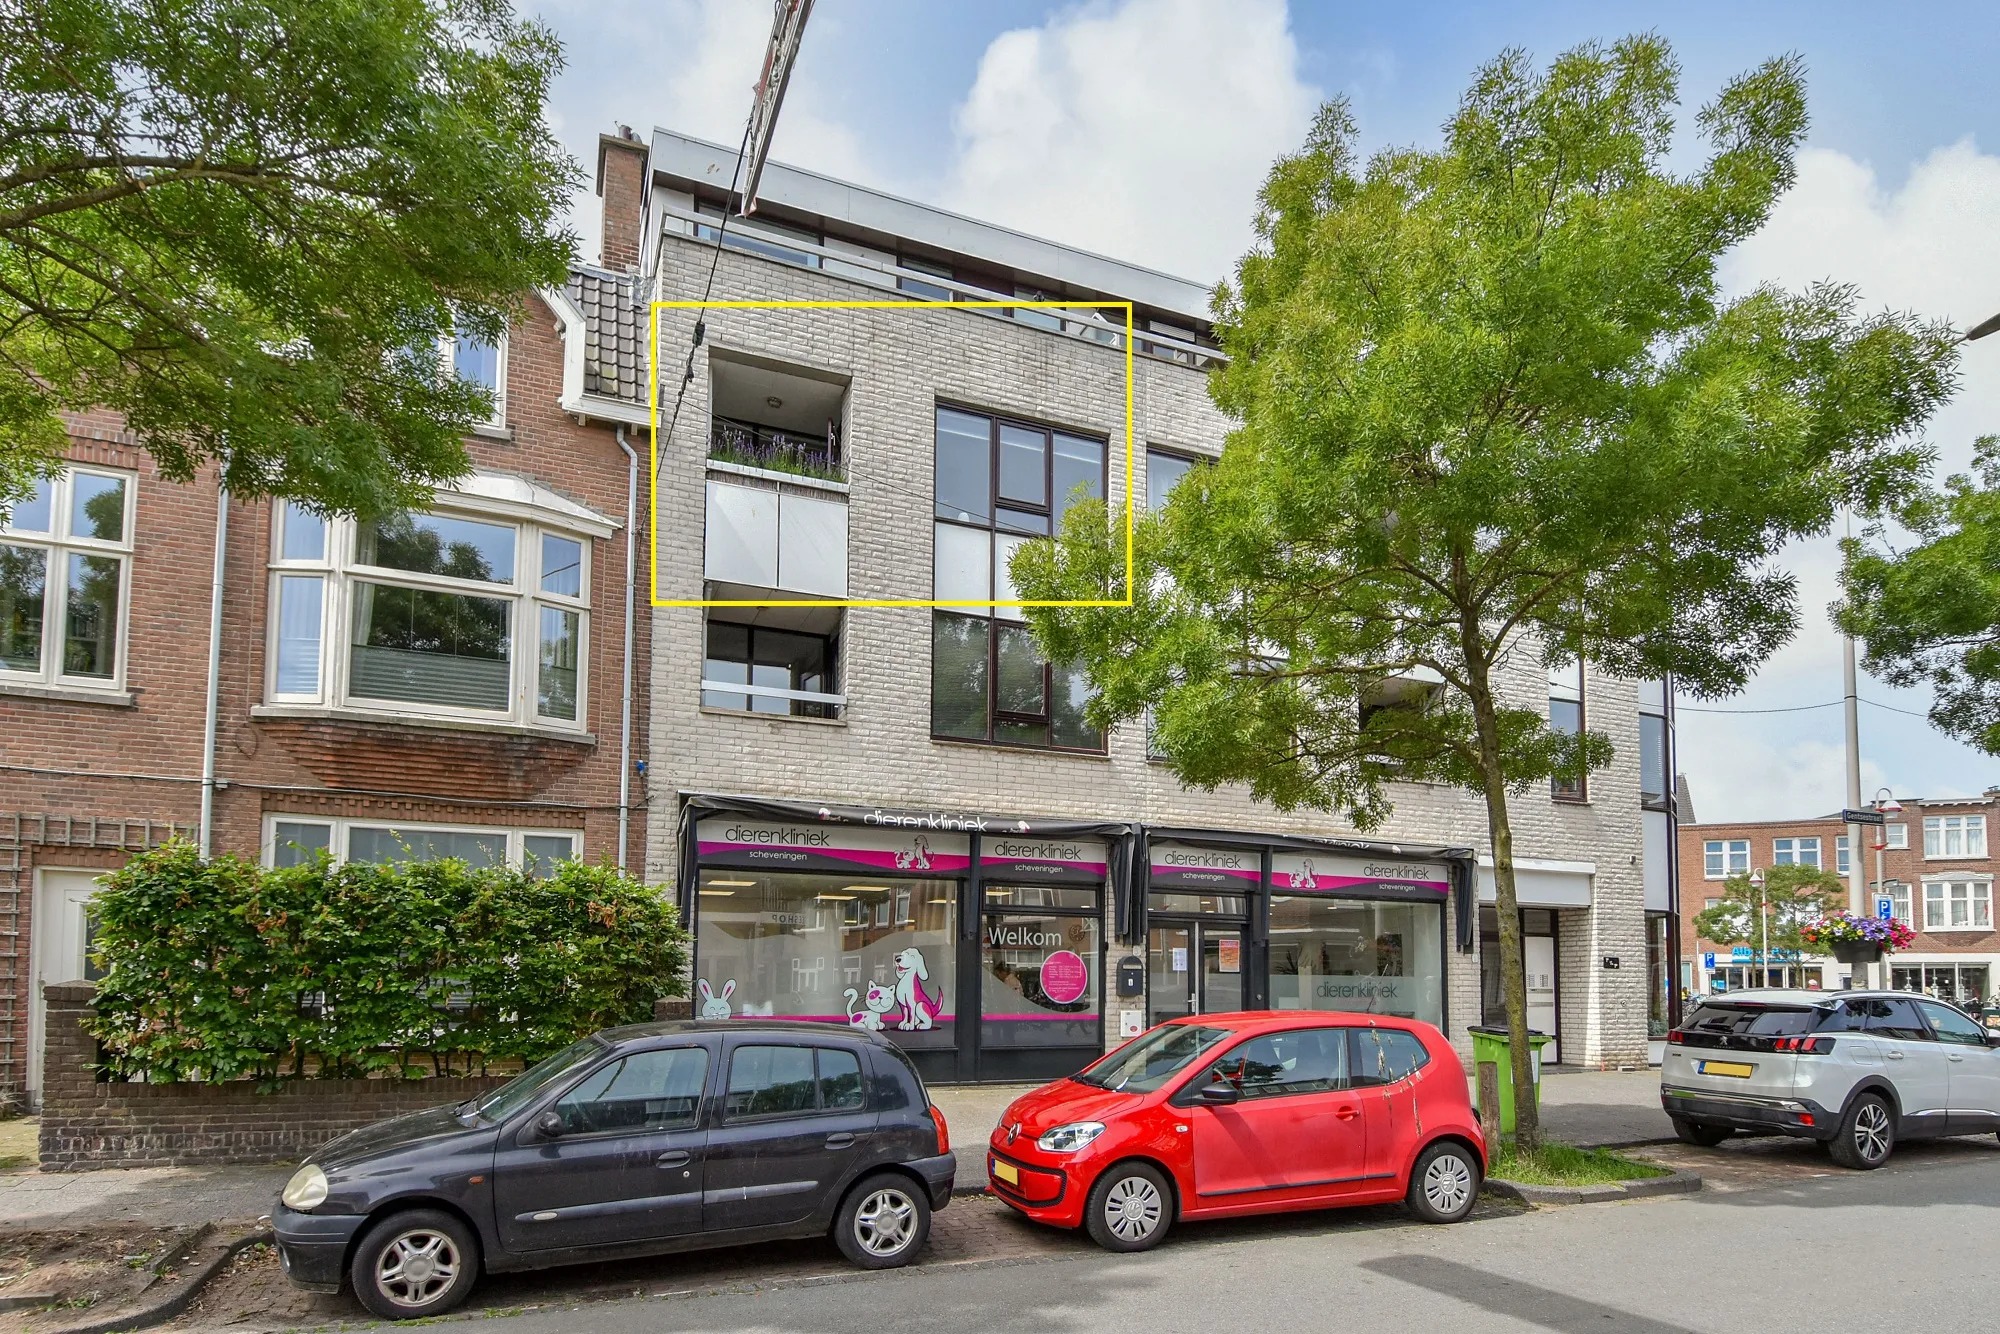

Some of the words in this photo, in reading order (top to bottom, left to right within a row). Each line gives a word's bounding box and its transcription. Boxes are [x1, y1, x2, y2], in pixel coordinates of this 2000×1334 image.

[863, 809, 989, 832] dierenkliniek
[725, 825, 830, 847] dierenkliniek
[749, 850, 807, 861] scheveningen
[994, 841, 1082, 860] dierenkliniek
[1164, 850, 1241, 869] dierenkliniek
[1015, 864, 1063, 874] scheveningen
[1182, 872, 1226, 881] scheveningen
[1363, 863, 1430, 880] dierenkliniek
[1378, 883, 1416, 892] scheveningen
[1881, 901, 1888, 913] P
[988, 926, 1062, 946] Welkom
[1706, 953, 1713, 962] P
[1317, 981, 1398, 998] dierenkliniek
